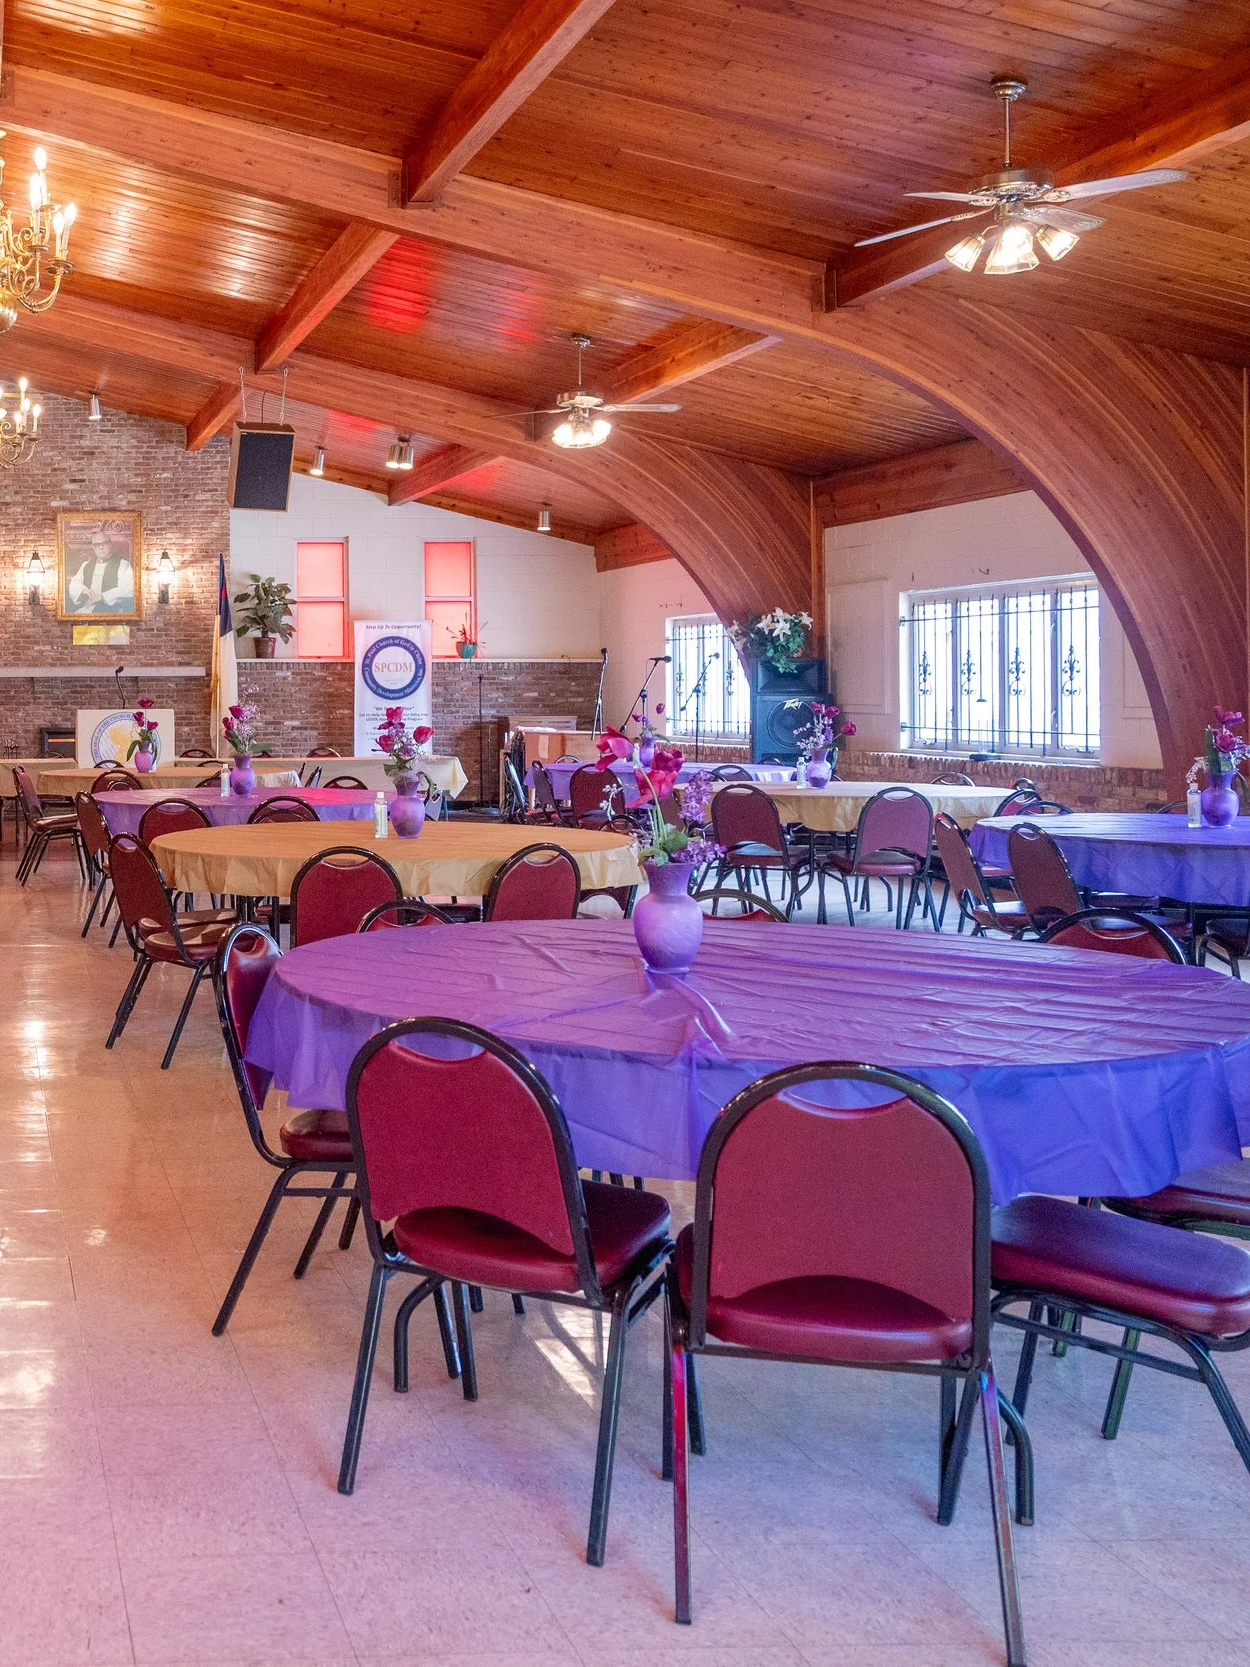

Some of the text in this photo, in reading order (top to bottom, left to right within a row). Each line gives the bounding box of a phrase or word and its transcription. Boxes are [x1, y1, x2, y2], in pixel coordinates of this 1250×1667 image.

[376, 639, 393, 647] Church
[400, 639, 410, 647] God
[374, 663, 413, 672] SPCDM
